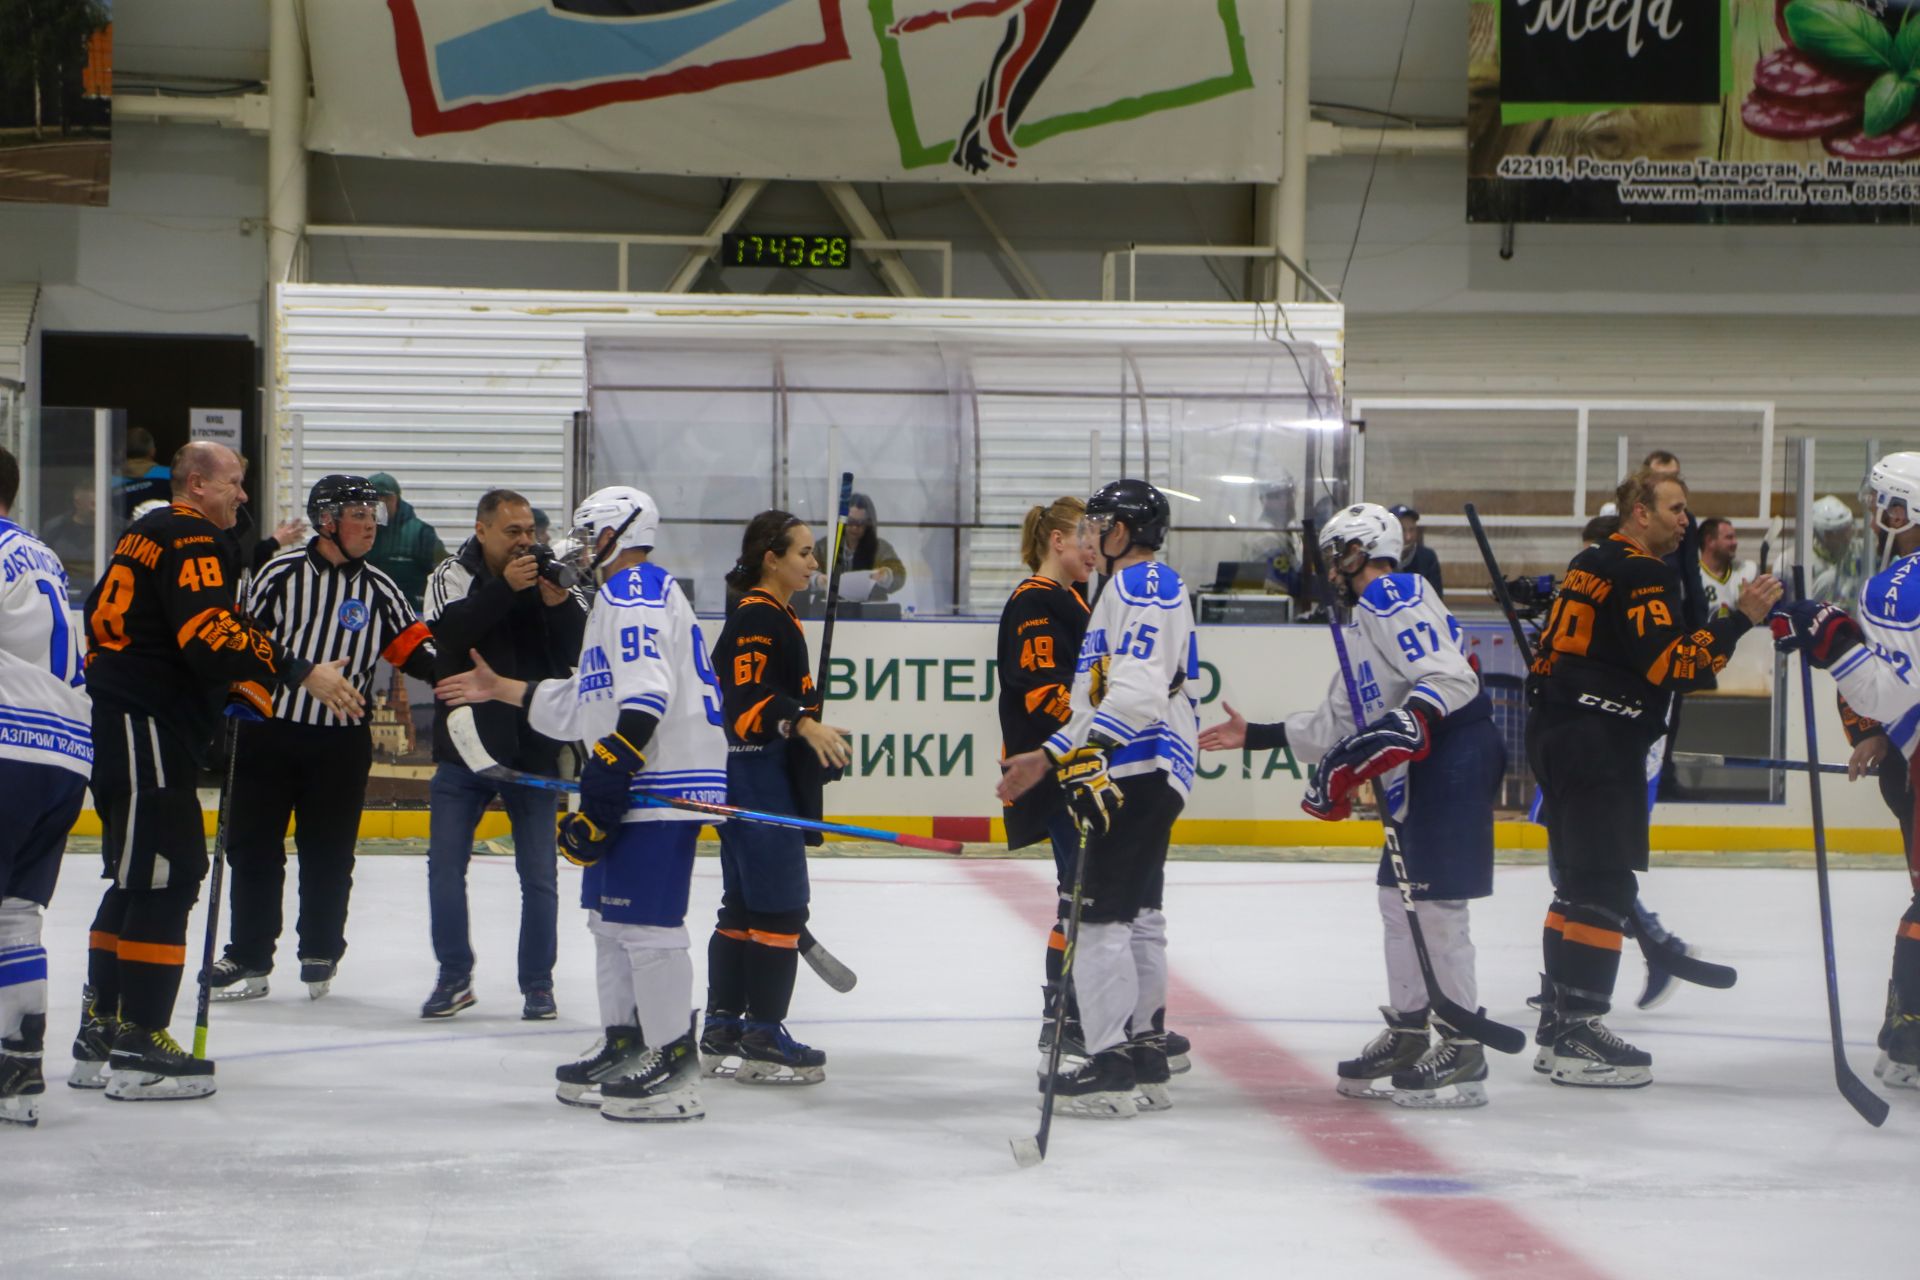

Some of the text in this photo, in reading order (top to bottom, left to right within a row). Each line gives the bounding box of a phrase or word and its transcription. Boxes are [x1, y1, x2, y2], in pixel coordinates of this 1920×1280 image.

[1499, 158, 1571, 180] 422191,
[1577, 158, 1692, 182] Республика
[1698, 160, 1803, 181] Татарстан,
[178, 556, 224, 592] 48
[1627, 599, 1673, 638] 79
[620, 625, 661, 663] 95
[1020, 636, 1056, 672] 49
[1396, 621, 1440, 663] 97
[734, 651, 768, 686] 67
[1578, 693, 1643, 719] CCM
[0, 727, 54, 750] АЗПРОМ
